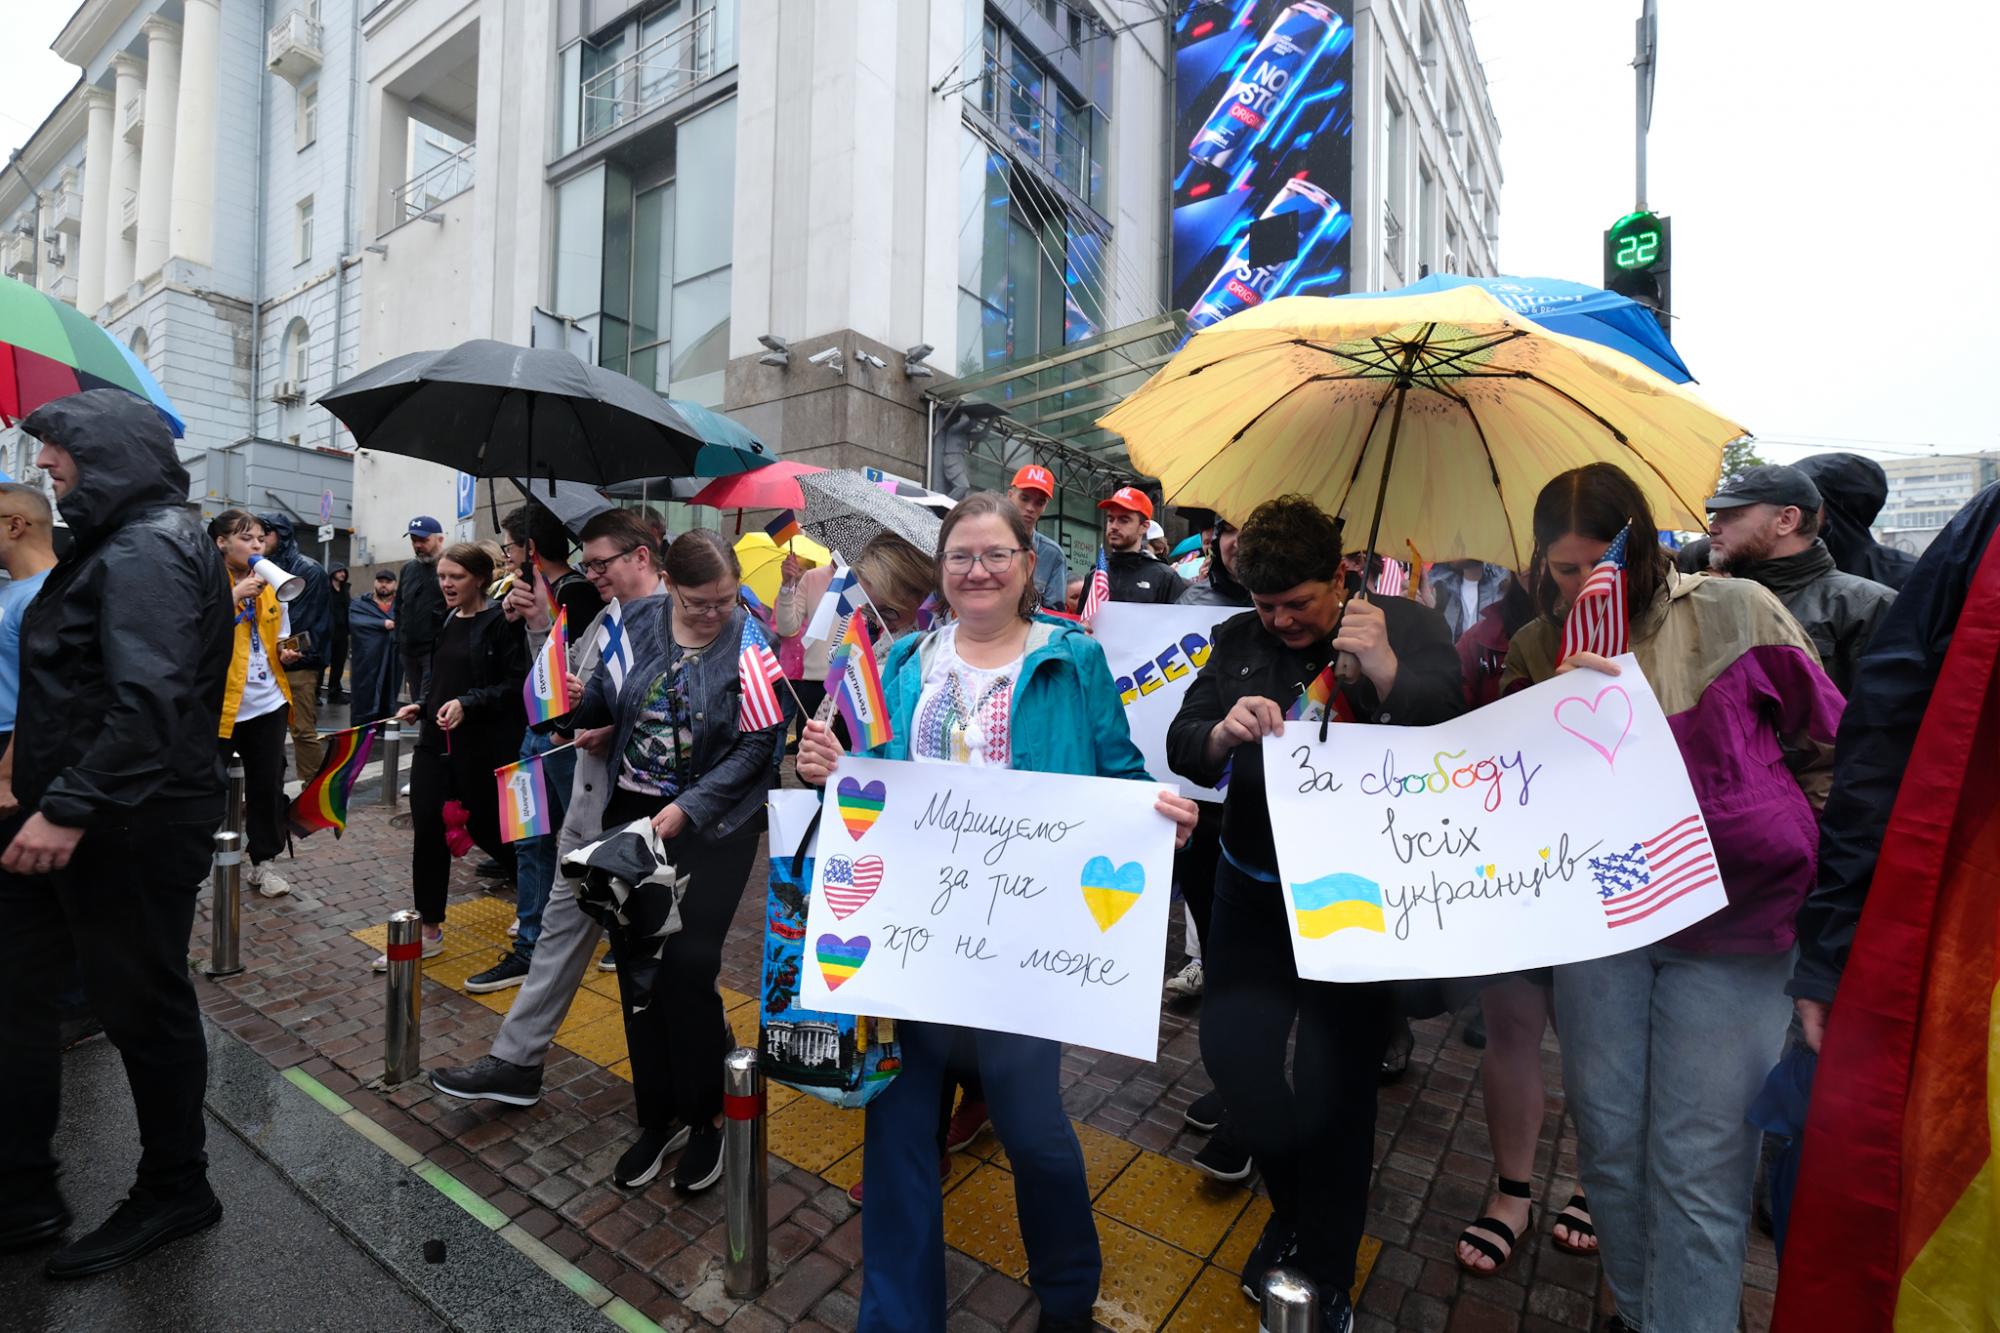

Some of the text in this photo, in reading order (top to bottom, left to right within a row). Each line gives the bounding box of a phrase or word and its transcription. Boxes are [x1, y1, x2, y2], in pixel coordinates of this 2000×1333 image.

[1617, 231, 1657, 267] 22
[460, 469, 471, 513] P
[872, 471, 879, 482] 7
[1027, 468, 1047, 484] NL
[1113, 486, 1133, 501] NL
[1115, 633, 1214, 706] REED
[1291, 745, 1542, 812] За свободу
[1381, 807, 1481, 864] всіх
[930, 866, 1048, 926] за тих
[1385, 832, 1604, 941] українців
[883, 924, 1130, 987] хто не може
